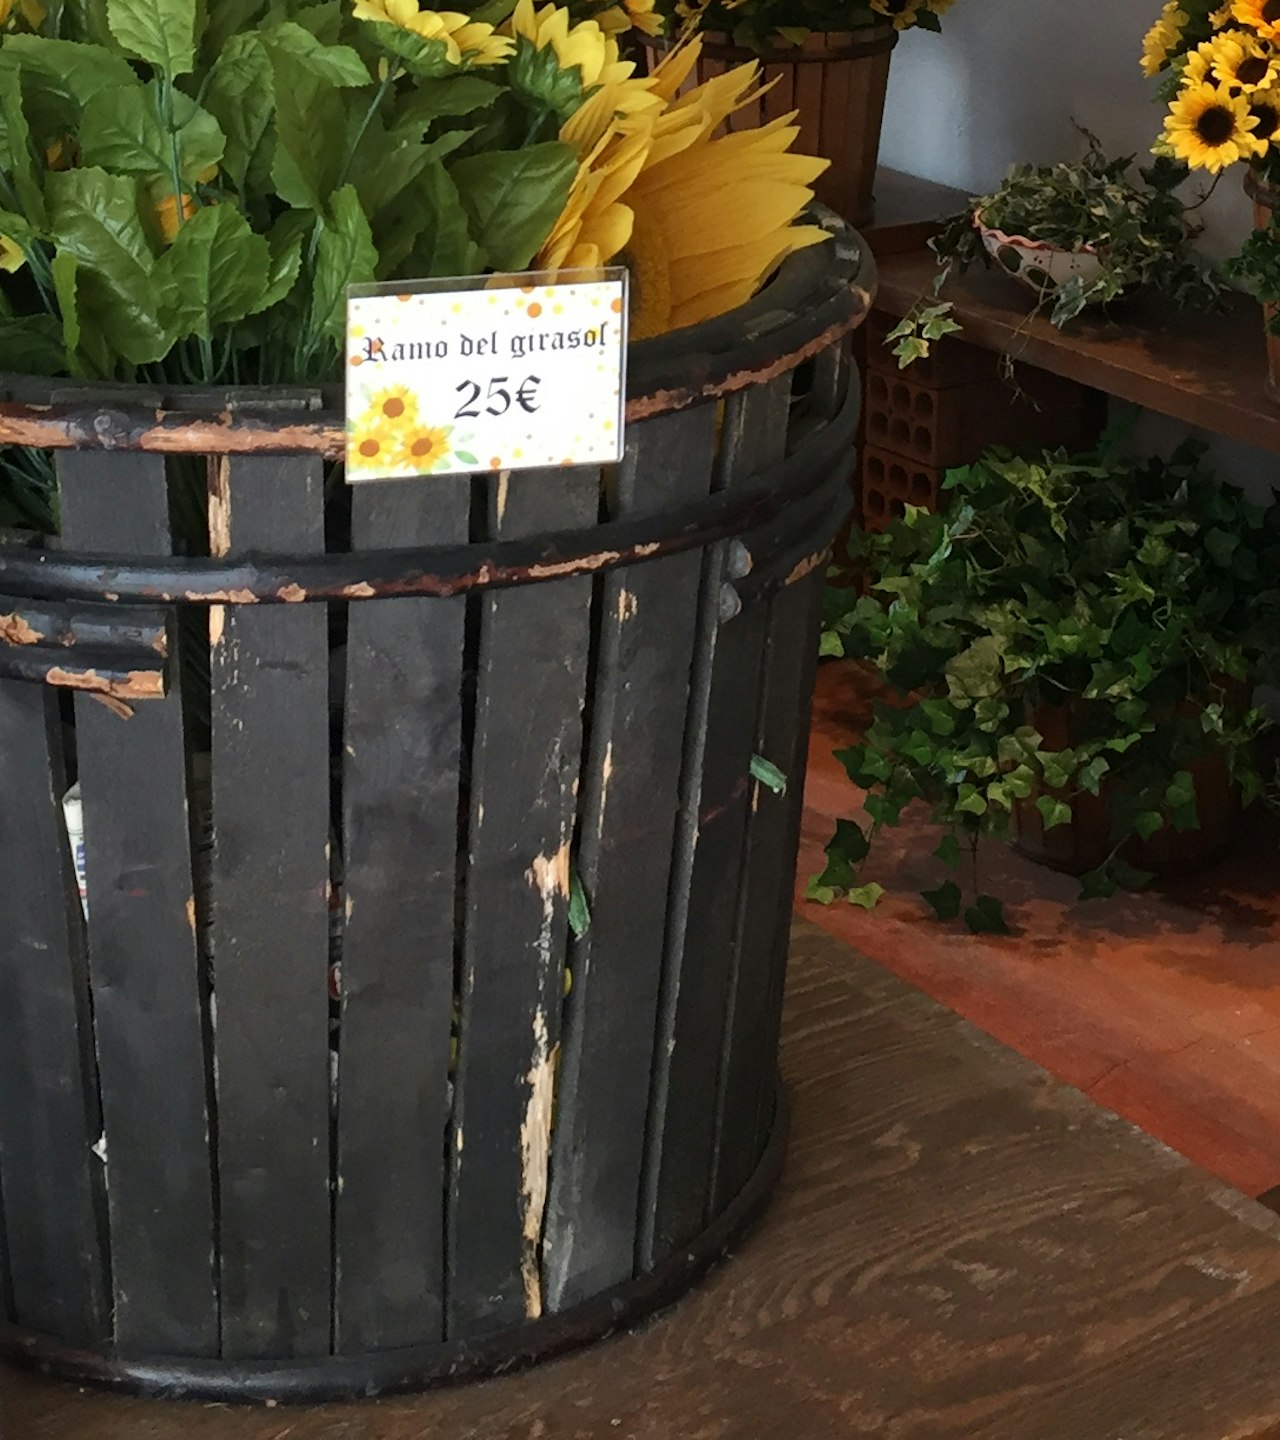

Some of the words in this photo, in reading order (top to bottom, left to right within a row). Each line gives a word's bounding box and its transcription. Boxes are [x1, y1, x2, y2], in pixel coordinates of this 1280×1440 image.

[362, 337, 449, 362] Ramo
[460, 331, 499, 357] del
[511, 321, 608, 358] girasol
[453, 375, 542, 419] 25€
